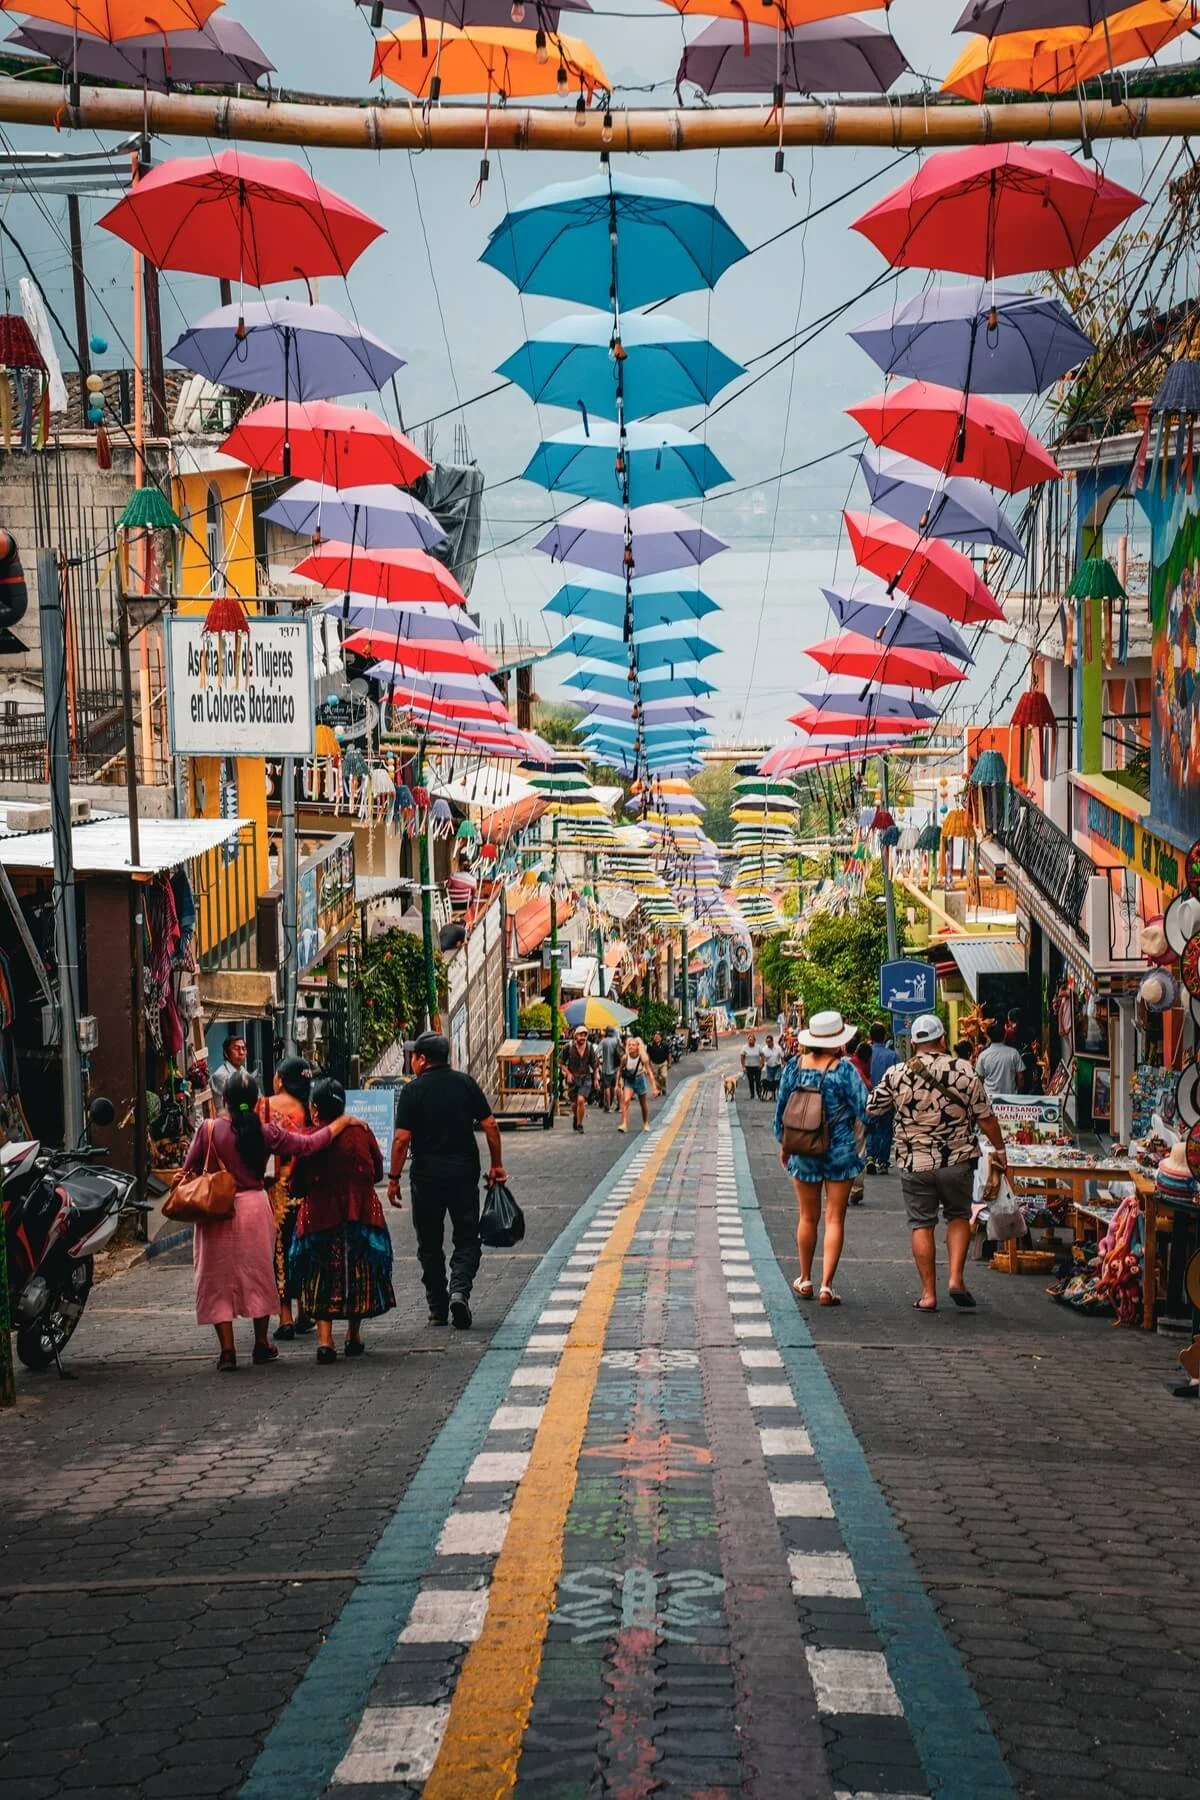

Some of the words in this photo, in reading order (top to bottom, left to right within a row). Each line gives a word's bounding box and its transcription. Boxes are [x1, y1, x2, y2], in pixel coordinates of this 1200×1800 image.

[278, 627, 300, 638] 1971
[242, 642, 254, 677] de
[255, 641, 293, 687] Mujeres
[190, 695, 204, 723] en
[206, 686, 246, 724] Colores
[249, 685, 295, 724] Botanico
[995, 1105, 1043, 1114] ARTESANOS
